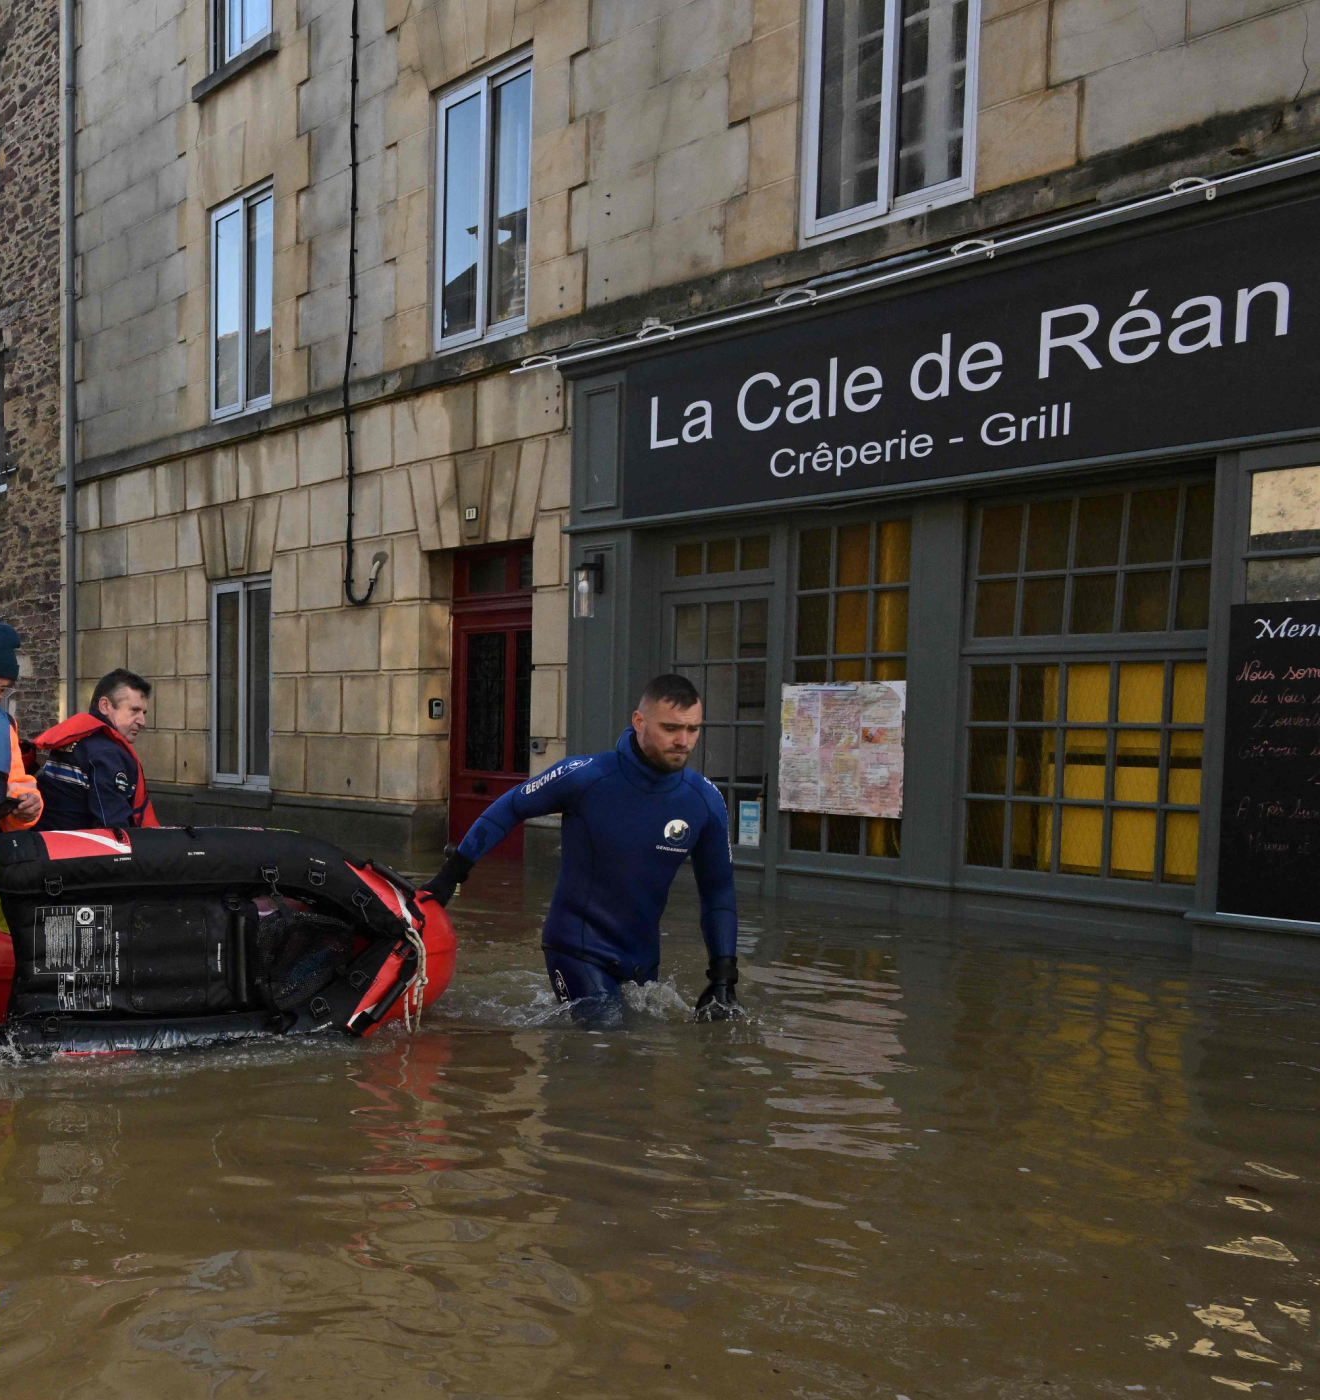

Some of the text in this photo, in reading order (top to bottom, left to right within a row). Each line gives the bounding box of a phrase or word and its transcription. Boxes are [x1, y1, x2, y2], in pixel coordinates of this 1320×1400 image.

[650, 281, 1289, 450] La Cale de Réan
[770, 428, 934, 478] Crêperie
[980, 401, 1072, 448] Grill
[1254, 617, 1320, 639] Men
[1236, 660, 1275, 681] Nous
[525, 766, 564, 795] BEUCHAT
